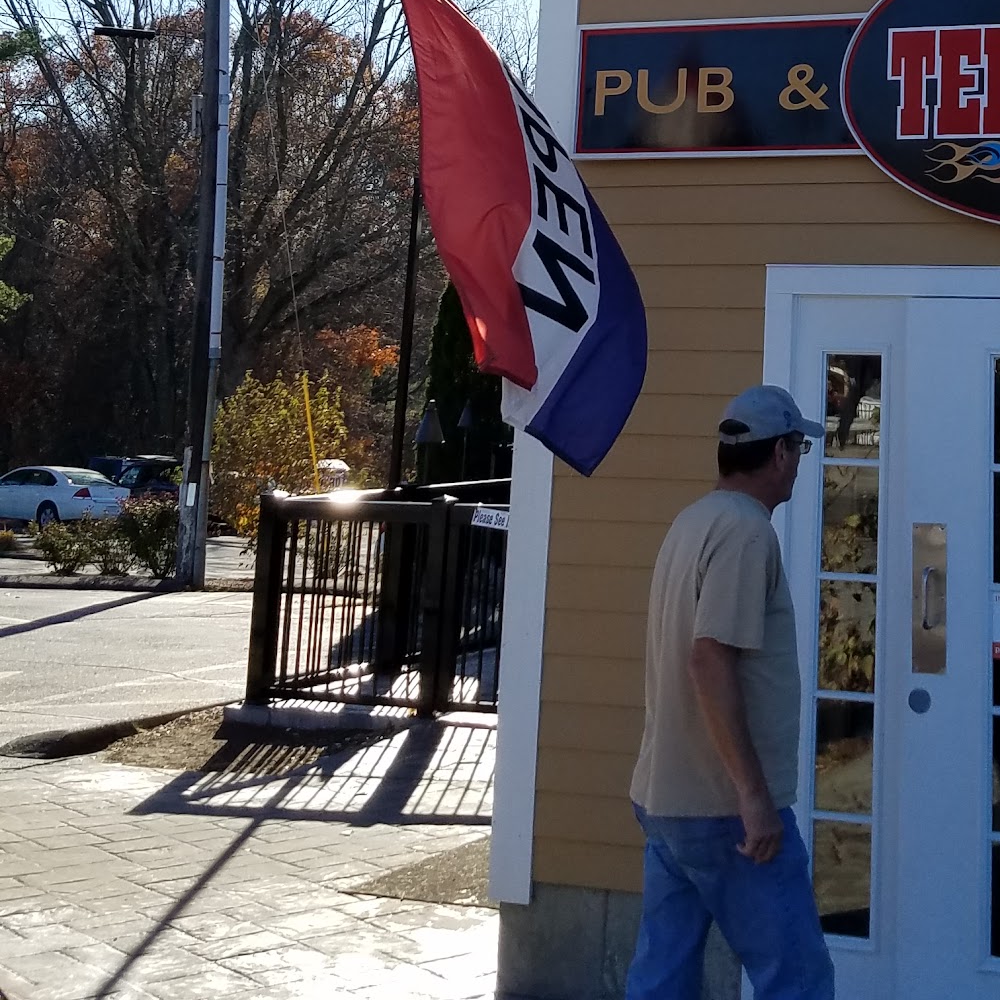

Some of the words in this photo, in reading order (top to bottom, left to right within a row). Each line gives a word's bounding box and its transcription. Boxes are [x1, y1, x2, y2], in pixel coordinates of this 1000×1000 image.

[594, 66, 735, 116] PUB
[778, 63, 830, 111] &
[473, 510, 493, 524] Please
[494, 512, 505, 526] See
